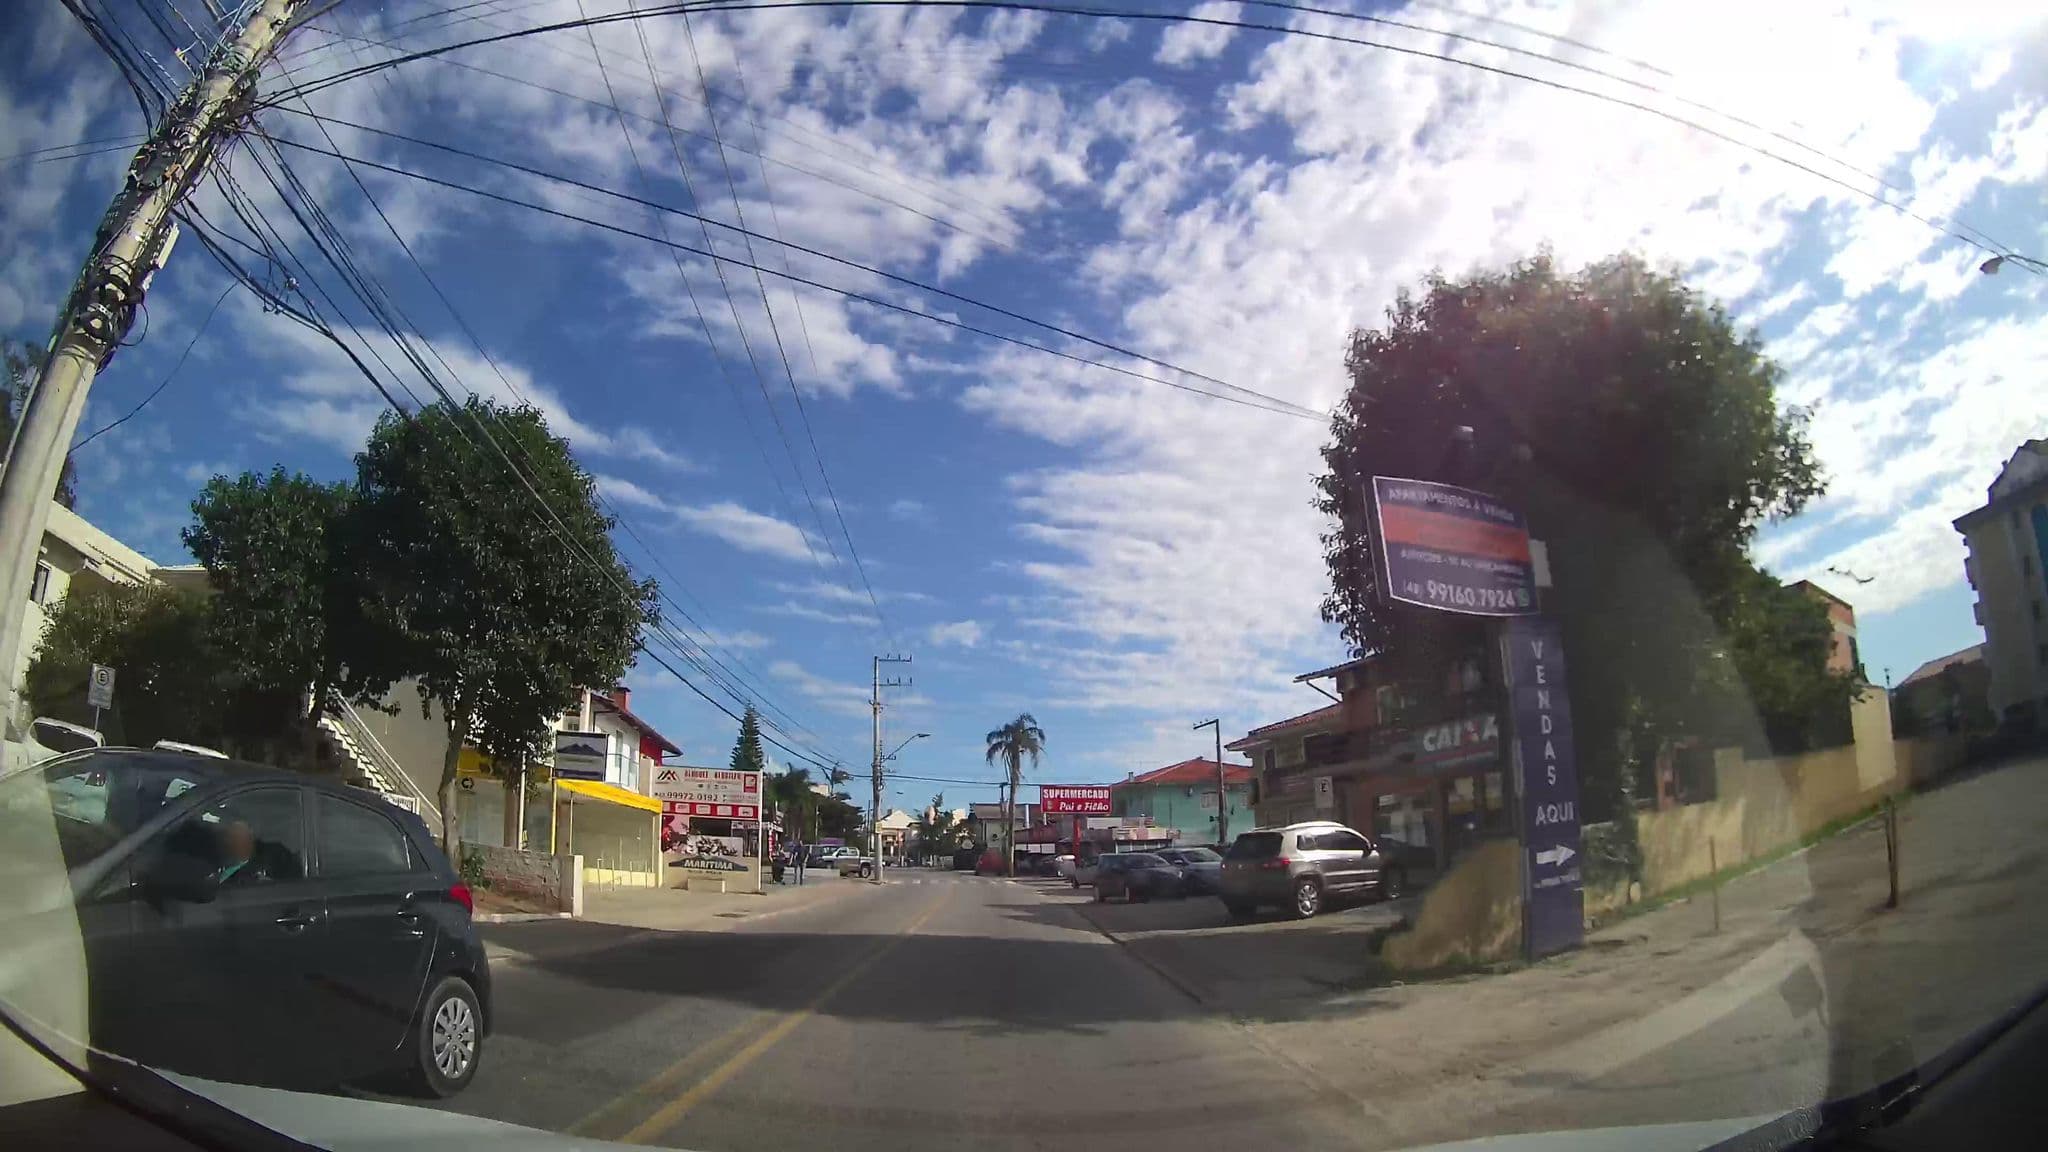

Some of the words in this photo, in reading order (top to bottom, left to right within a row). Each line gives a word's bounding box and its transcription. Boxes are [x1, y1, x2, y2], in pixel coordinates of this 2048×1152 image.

[1531, 640, 1557, 785] VENDAS
[1423, 715, 1499, 751] CAIXA
[1043, 788, 1110, 799] SUPERMERCADO
[1084, 801, 1109, 811] Filho
[1535, 801, 1575, 827] AQUI
[684, 860, 733, 870] MARITIMA
